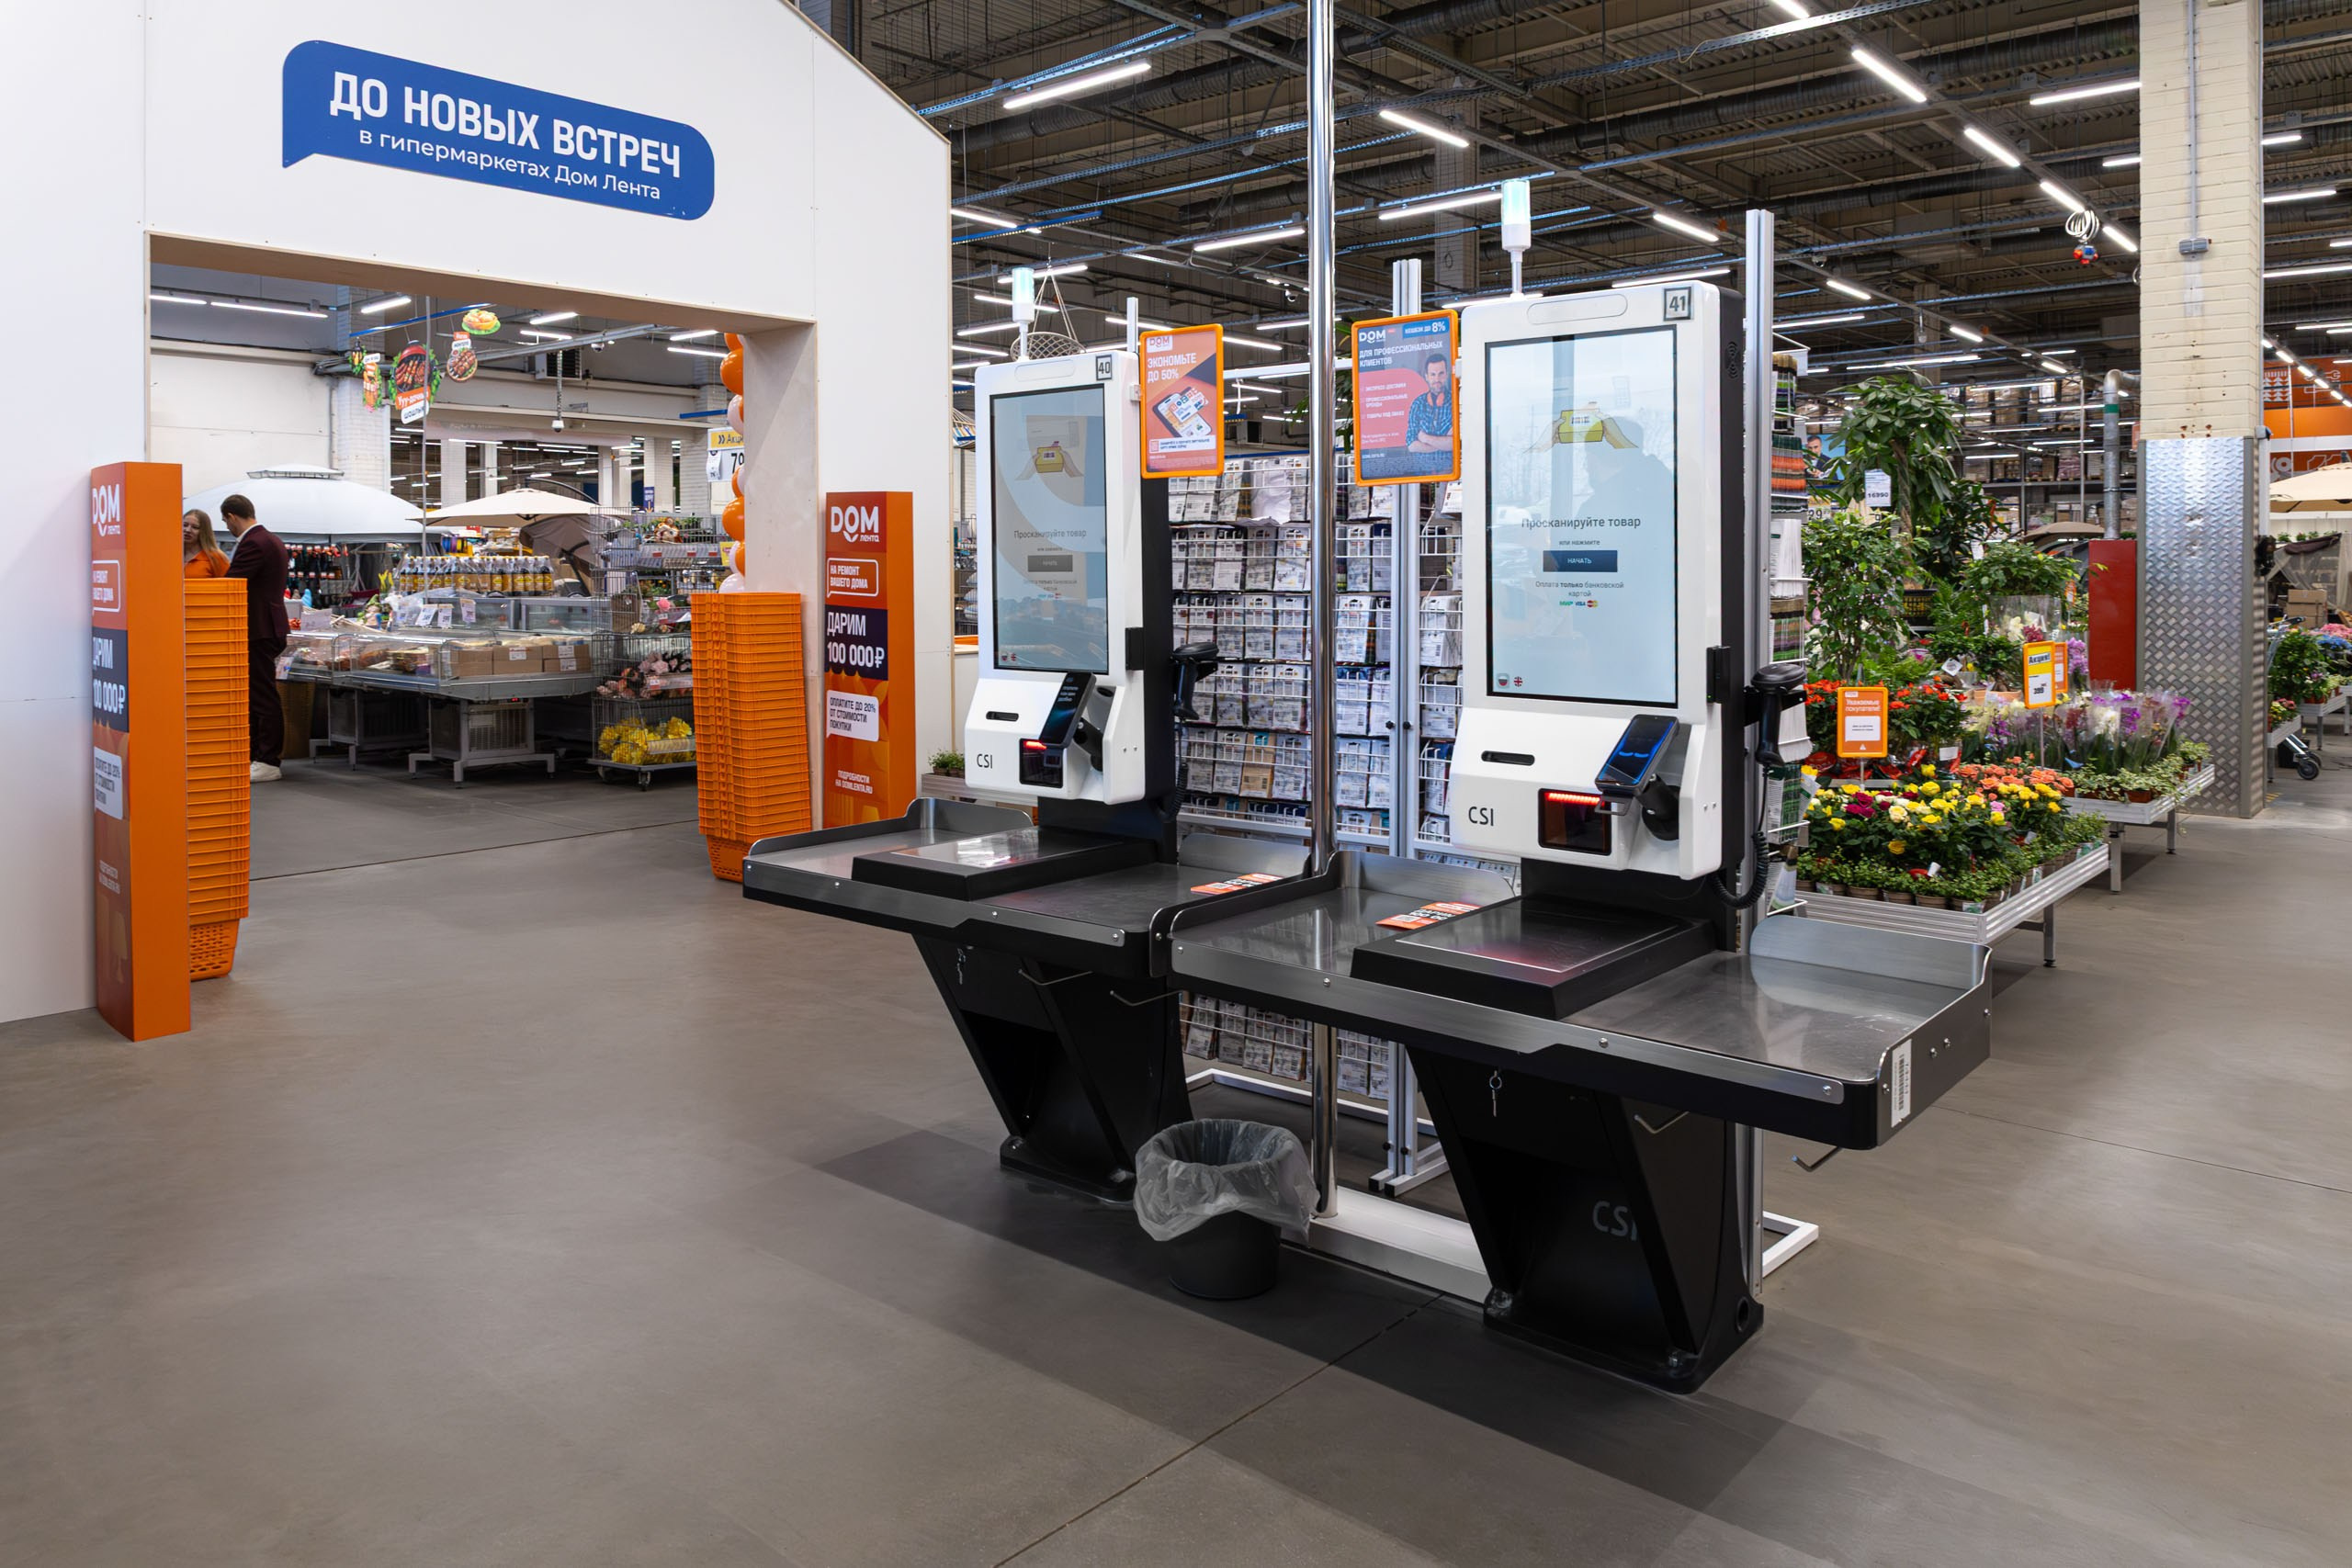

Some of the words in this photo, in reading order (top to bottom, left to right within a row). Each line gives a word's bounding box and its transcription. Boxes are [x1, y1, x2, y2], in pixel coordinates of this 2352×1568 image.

[330, 71, 388, 121] ДО
[404, 85, 540, 151] НОВЫХ
[553, 118, 680, 178] ВСТРЕЧ
[359, 130, 372, 144] в
[379, 133, 550, 179] гипермаркетах
[554, 164, 597, 187] Дом
[602, 174, 661, 199] Лента
[1668, 293, 1687, 312] 41
[1431, 321, 1446, 333] 8%
[1359, 348, 1373, 358] ДЛЯ
[1374, 340, 1443, 357] ПРОФЕССИОНАЛЬНЫХ
[1098, 361, 1111, 375] 40
[1147, 353, 1197, 368] ЭКОНОМЬТЕ
[1359, 358, 1392, 368] КЛИЕНТОВ
[1147, 370, 1159, 384] ДО
[1161, 368, 1180, 380] 50%
[1521, 517, 1605, 530] Просканируйте
[1608, 517, 1641, 529] товар
[1067, 530, 1087, 539] товар
[838, 565, 860, 576] РЕМОНТ
[830, 577, 850, 588] ВАШЕГО
[851, 578, 868, 590] ДОМА
[1584, 581, 1624, 589] банковской
[827, 611, 866, 637] ДАРИМ
[827, 641, 846, 664] 100
[830, 697, 854, 710] ОПЛАТИТЕ
[855, 701, 864, 712] ДО
[864, 703, 876, 714] 20%
[837, 709, 867, 723] СТОИМОСТИ
[830, 719, 852, 732] ПОКУПКИ
[977, 753, 993, 769] CSI
[1468, 806, 1495, 826] CSI
[1593, 1201, 1638, 1241] CSI
